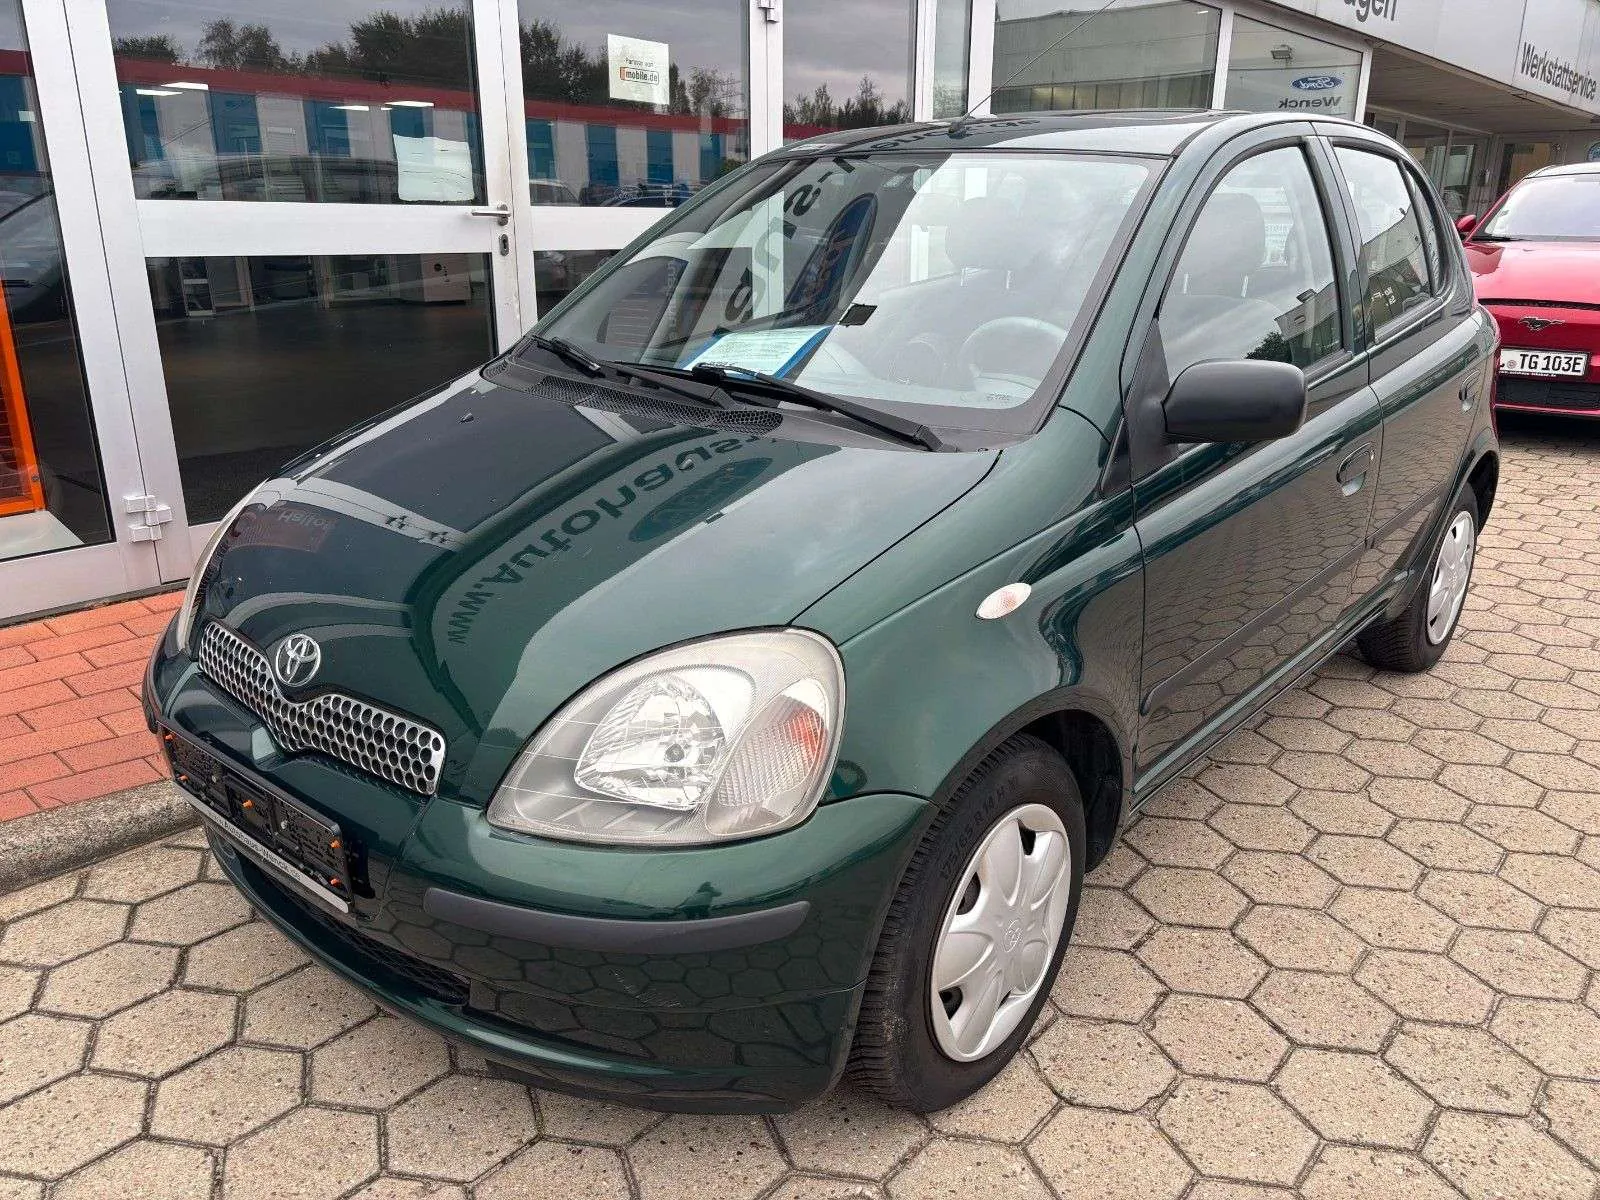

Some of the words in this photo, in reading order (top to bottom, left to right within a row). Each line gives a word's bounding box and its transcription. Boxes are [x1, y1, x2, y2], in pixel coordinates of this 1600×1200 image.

[625, 70, 658, 82] mobile.de
[1520, 41, 1597, 100] Werkstattservice
[1519, 353, 1539, 372] TG
[1541, 355, 1583, 373] 103E
